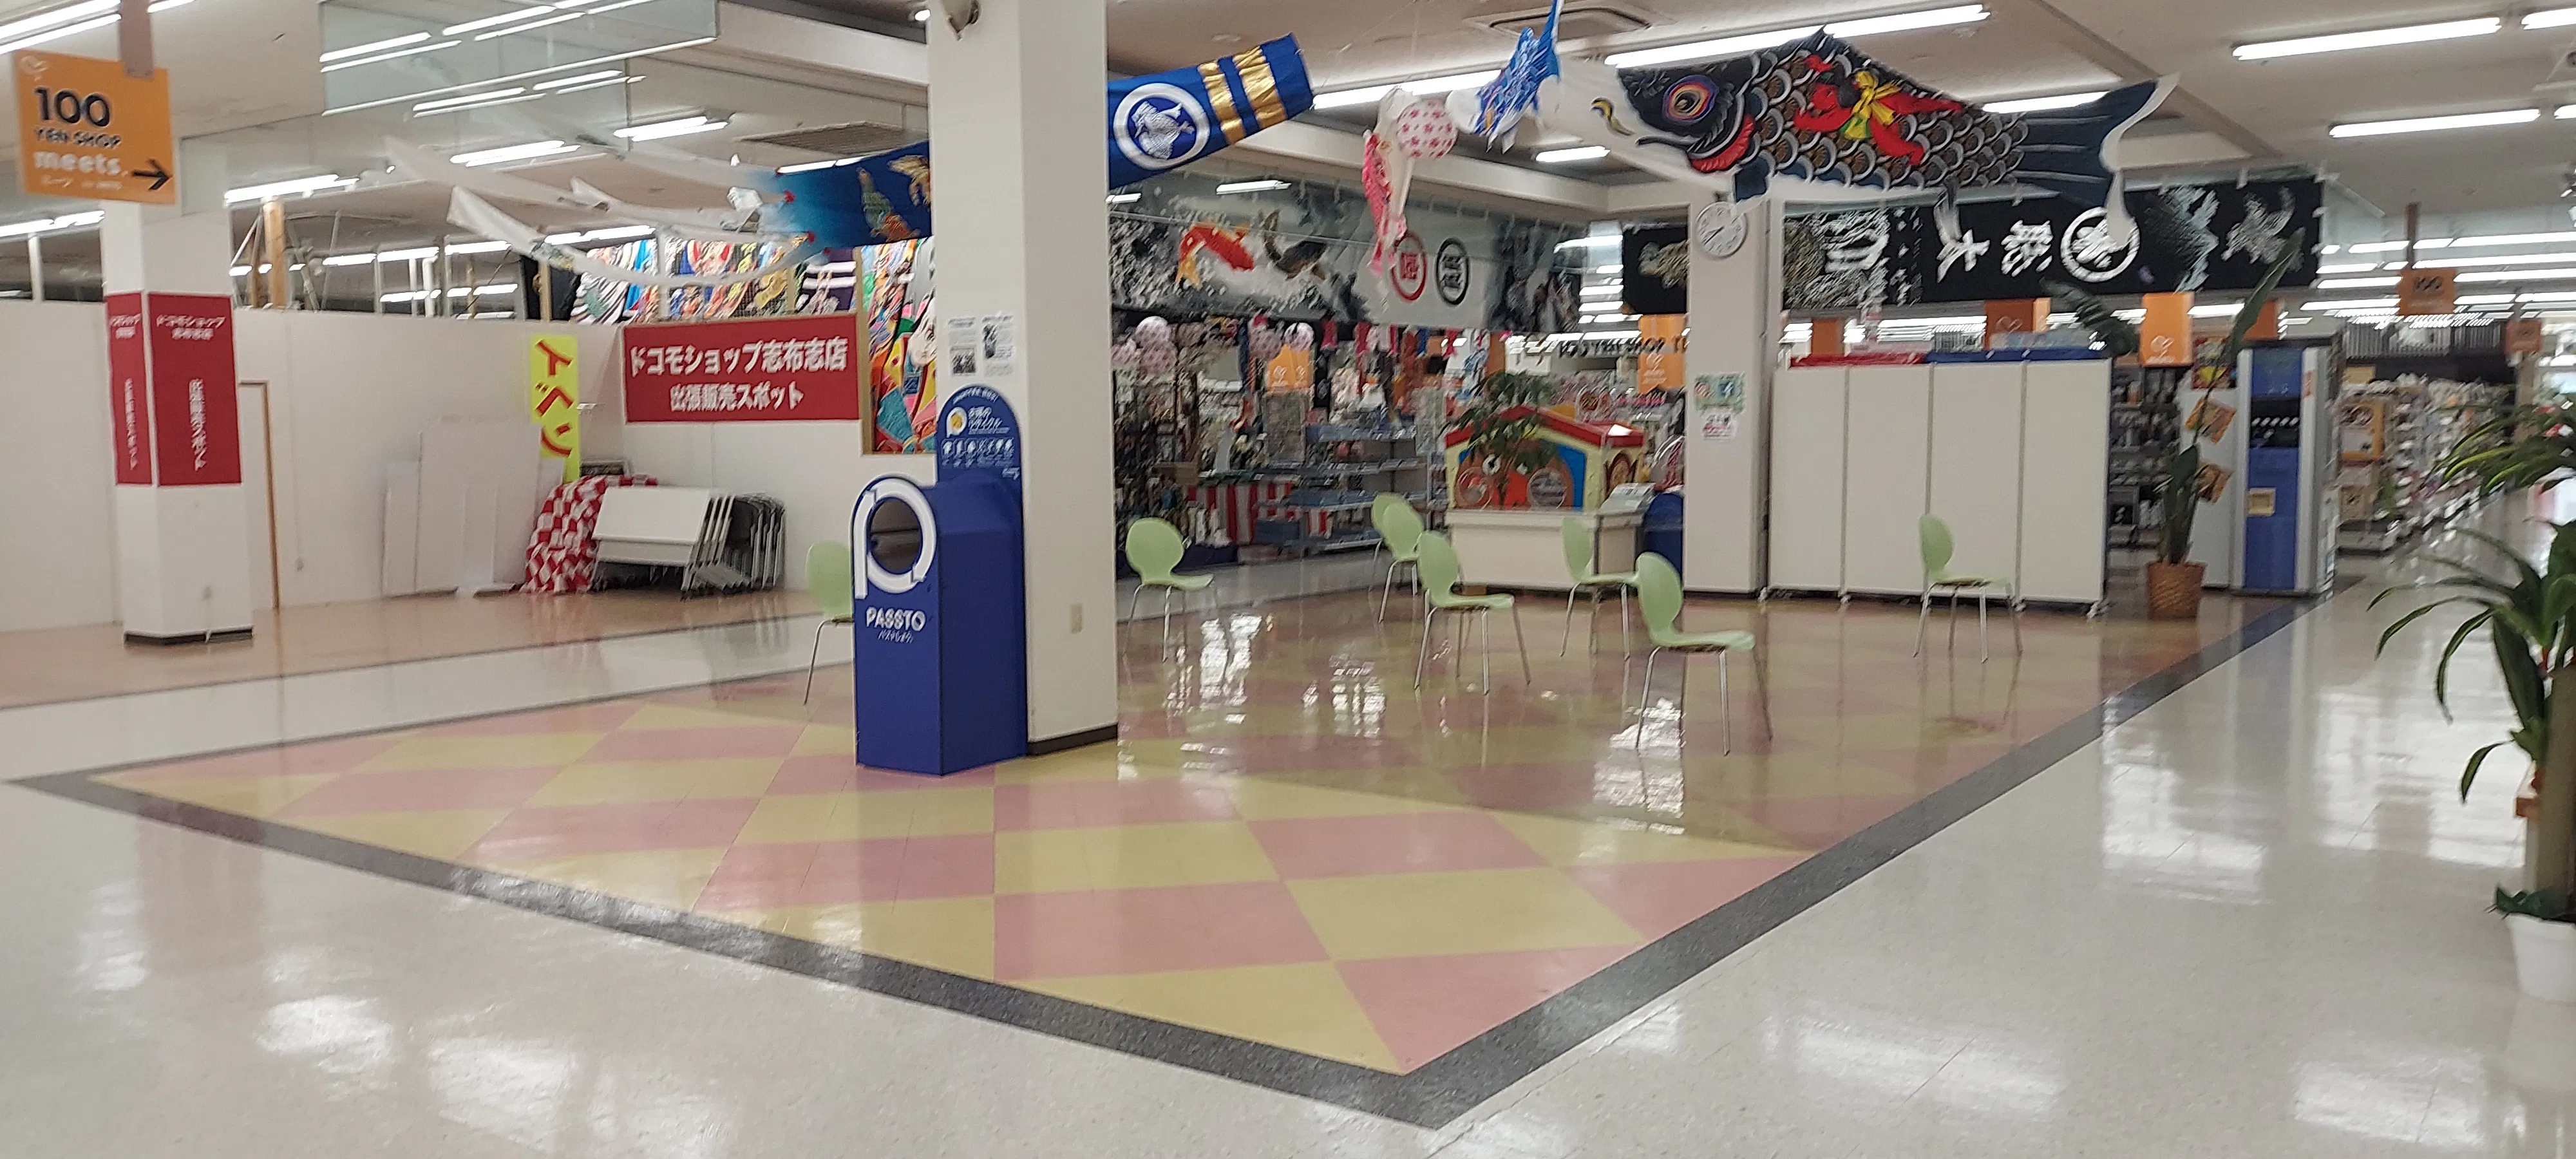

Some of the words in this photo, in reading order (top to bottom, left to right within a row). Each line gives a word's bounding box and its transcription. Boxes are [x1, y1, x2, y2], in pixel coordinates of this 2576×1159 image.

[35, 86, 110, 127] 100
[35, 127, 69, 143] YEN
[73, 131, 122, 149] SHOP
[630, 335, 849, 377] ドコモショップ志布志店
[670, 381, 804, 412] 出張販売スポット
[866, 606, 926, 631] PASSTO
